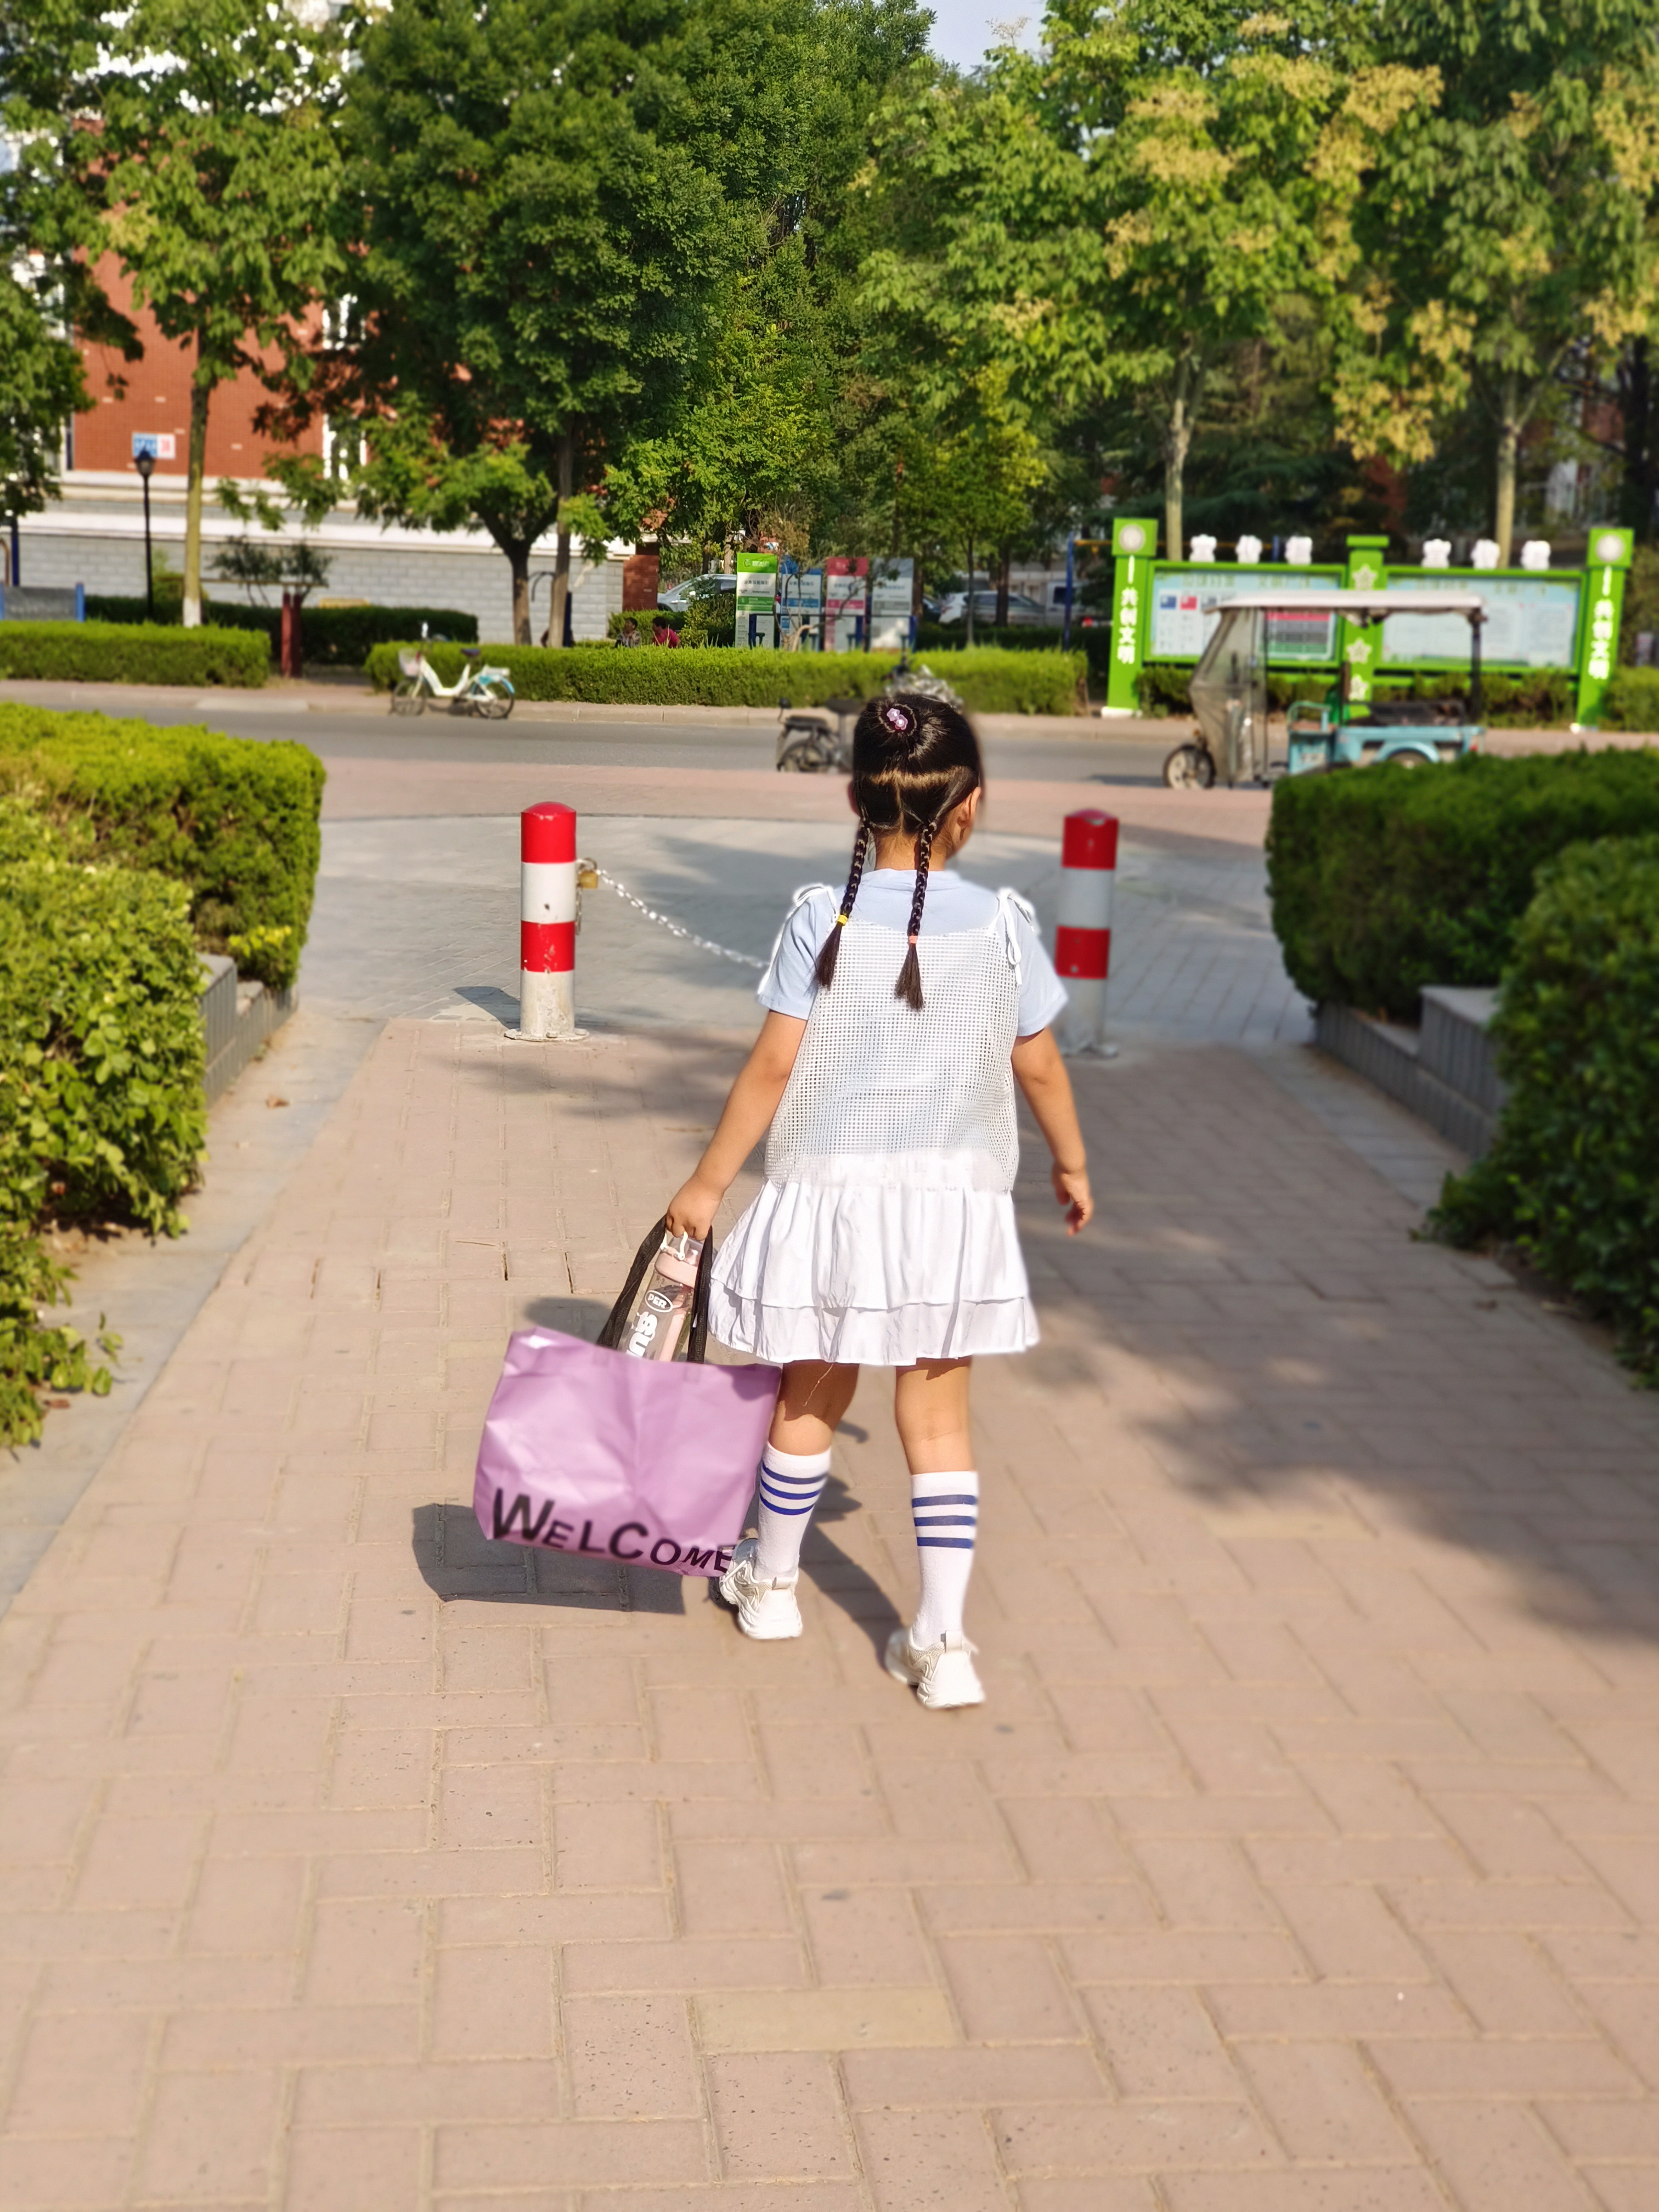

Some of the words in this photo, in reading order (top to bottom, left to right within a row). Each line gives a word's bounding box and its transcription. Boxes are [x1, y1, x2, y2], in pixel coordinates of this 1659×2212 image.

[647, 1293, 668, 1309] PER
[626, 1311, 658, 1357] SU
[493, 1487, 736, 1573] WELCOME
